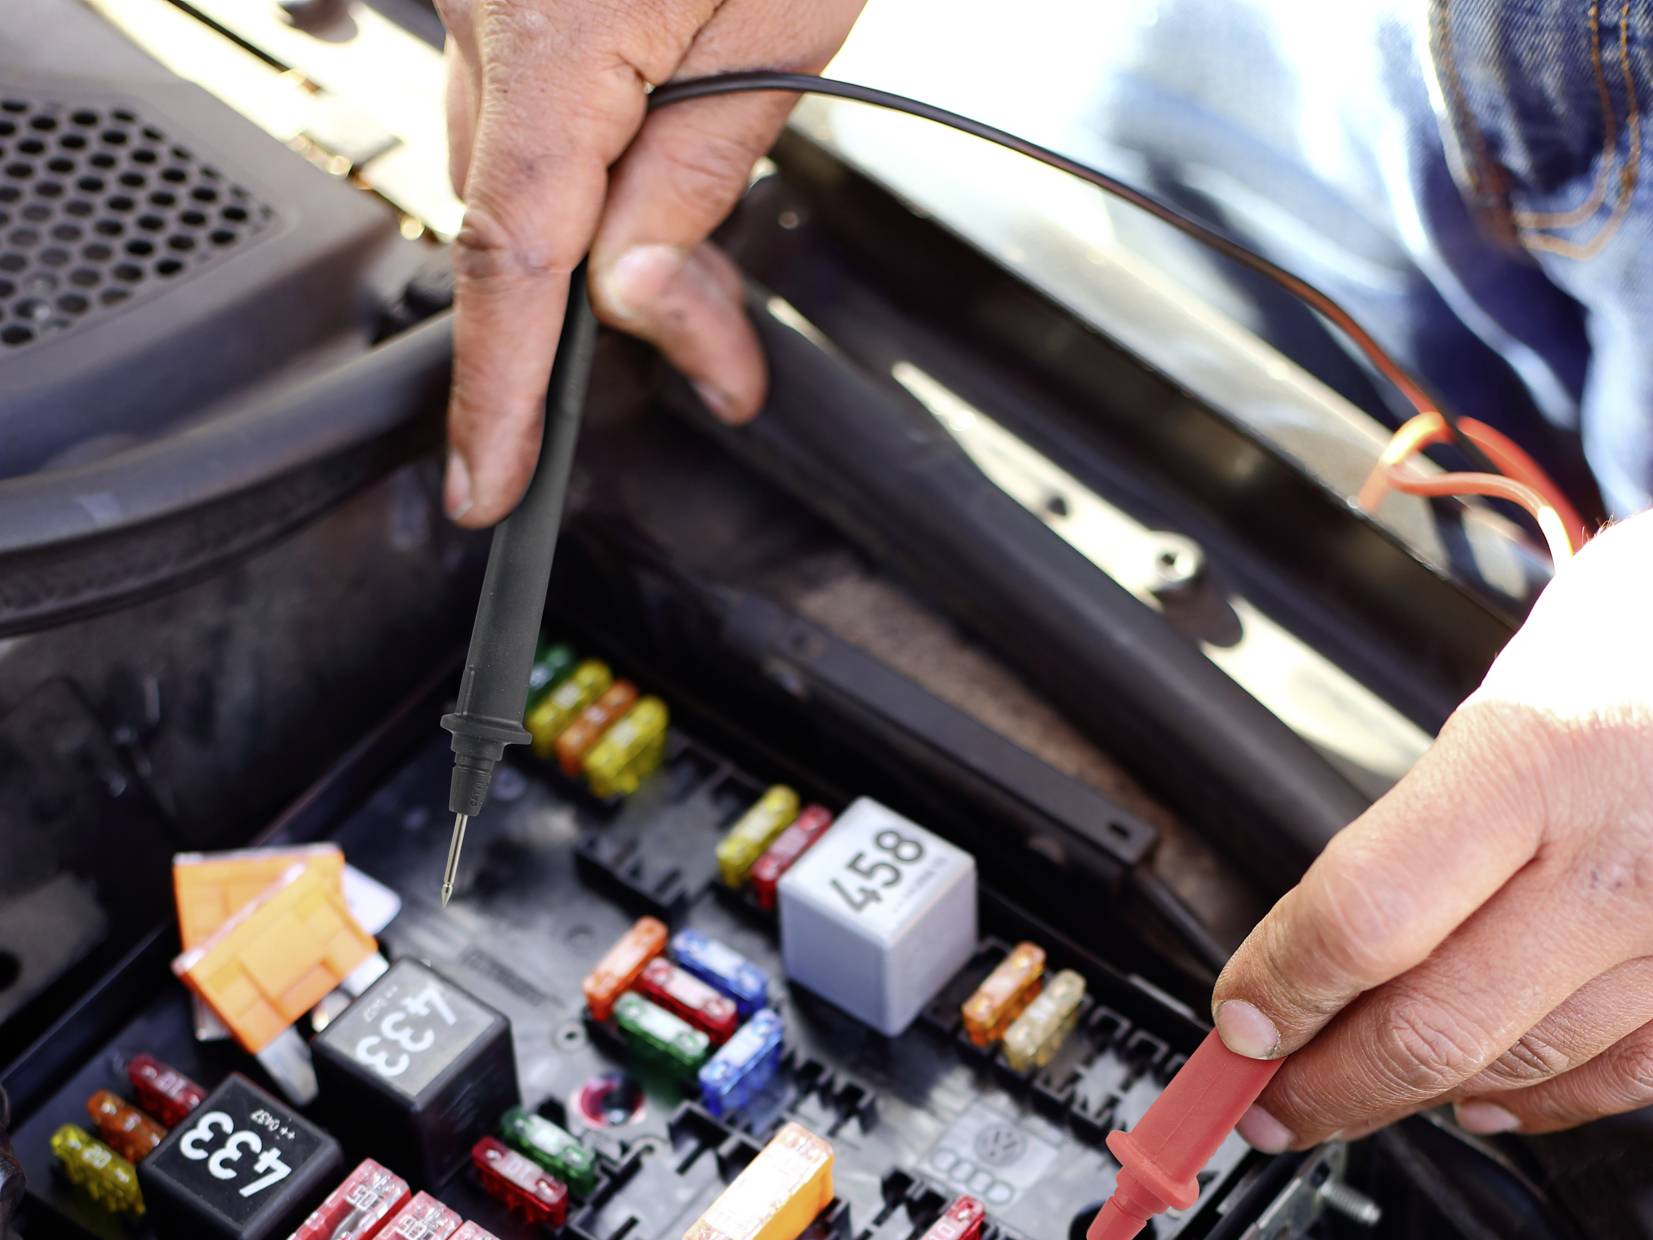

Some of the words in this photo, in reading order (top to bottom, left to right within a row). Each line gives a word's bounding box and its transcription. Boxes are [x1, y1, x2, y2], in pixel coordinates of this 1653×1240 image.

[829, 827, 926, 912] 458
[352, 971, 463, 1088] 433
[179, 1110, 292, 1197] 433
[250, 1108, 280, 1131] 0437
